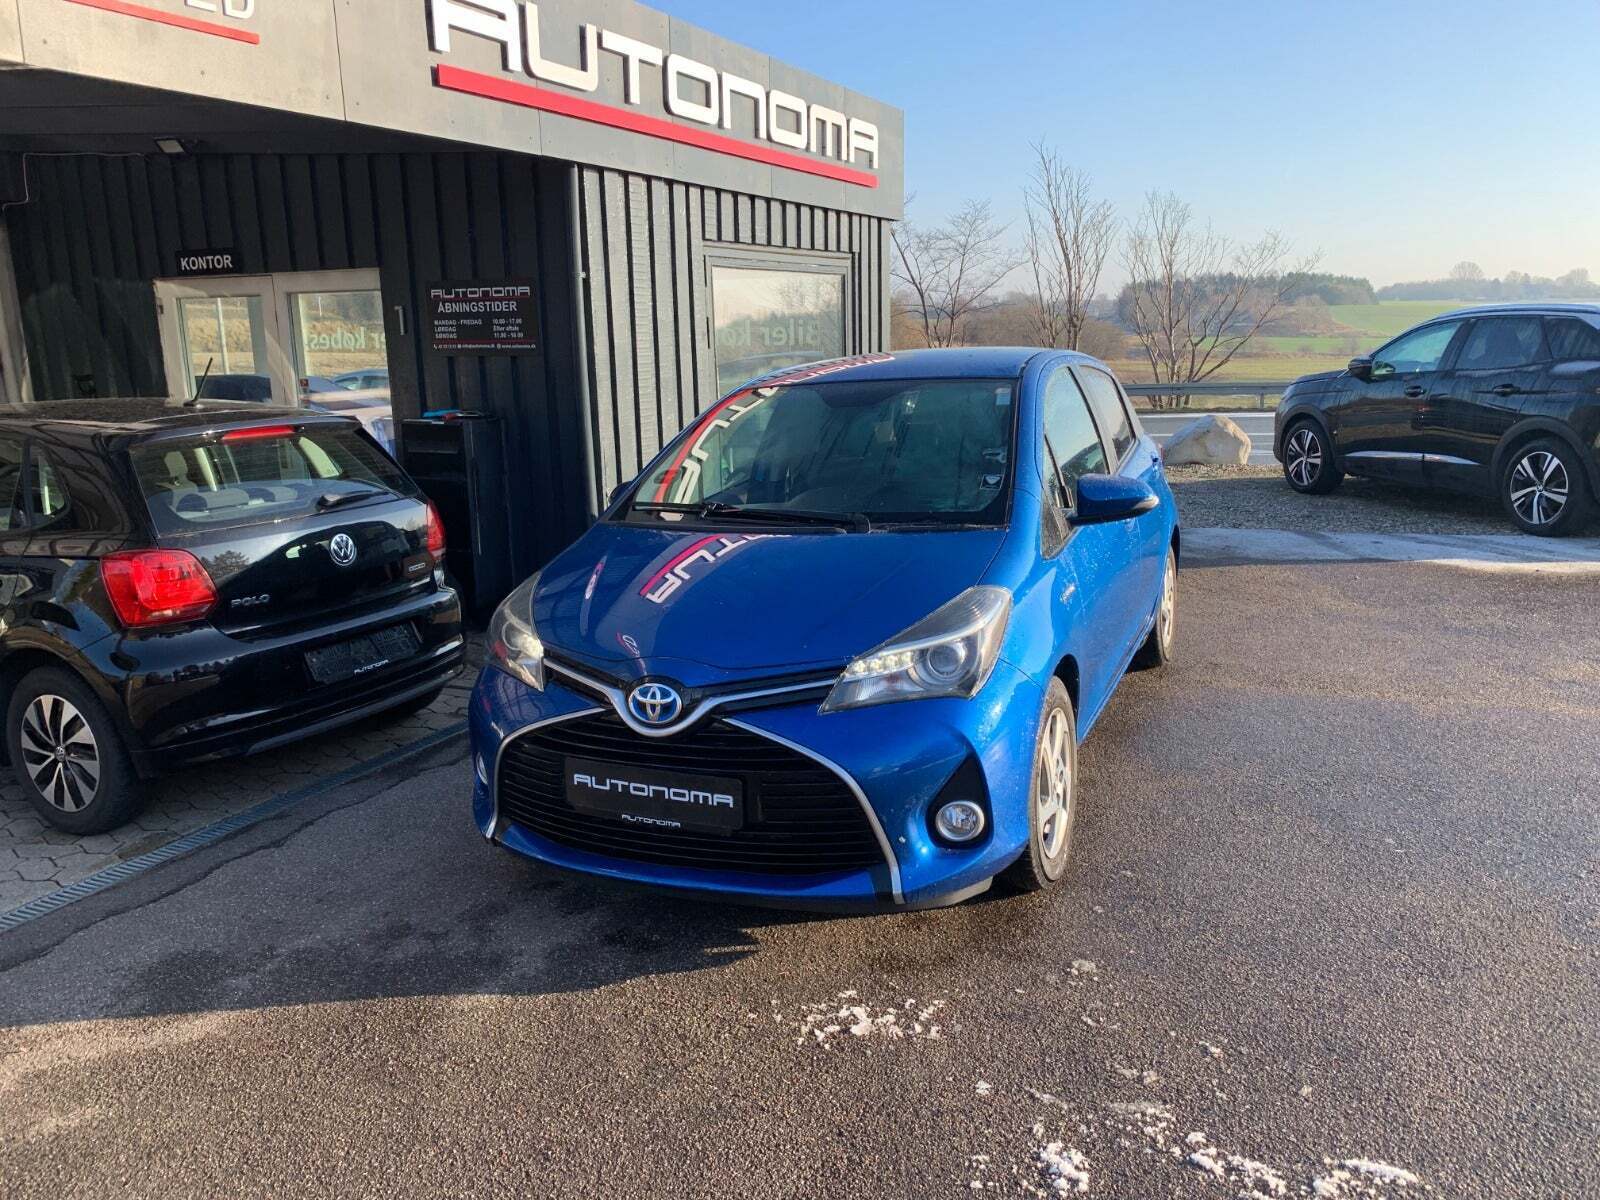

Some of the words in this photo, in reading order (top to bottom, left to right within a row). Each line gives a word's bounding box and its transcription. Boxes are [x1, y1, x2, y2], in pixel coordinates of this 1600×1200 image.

[432, 0, 879, 169] AUTONOMA
[180, 254, 234, 271] KONTOR
[431, 286, 530, 298] AUTONOMA
[437, 300, 518, 313] ÅBNINGSTIDER
[573, 773, 734, 808] AUTONOMA
[621, 814, 681, 828] AUTONOMA
